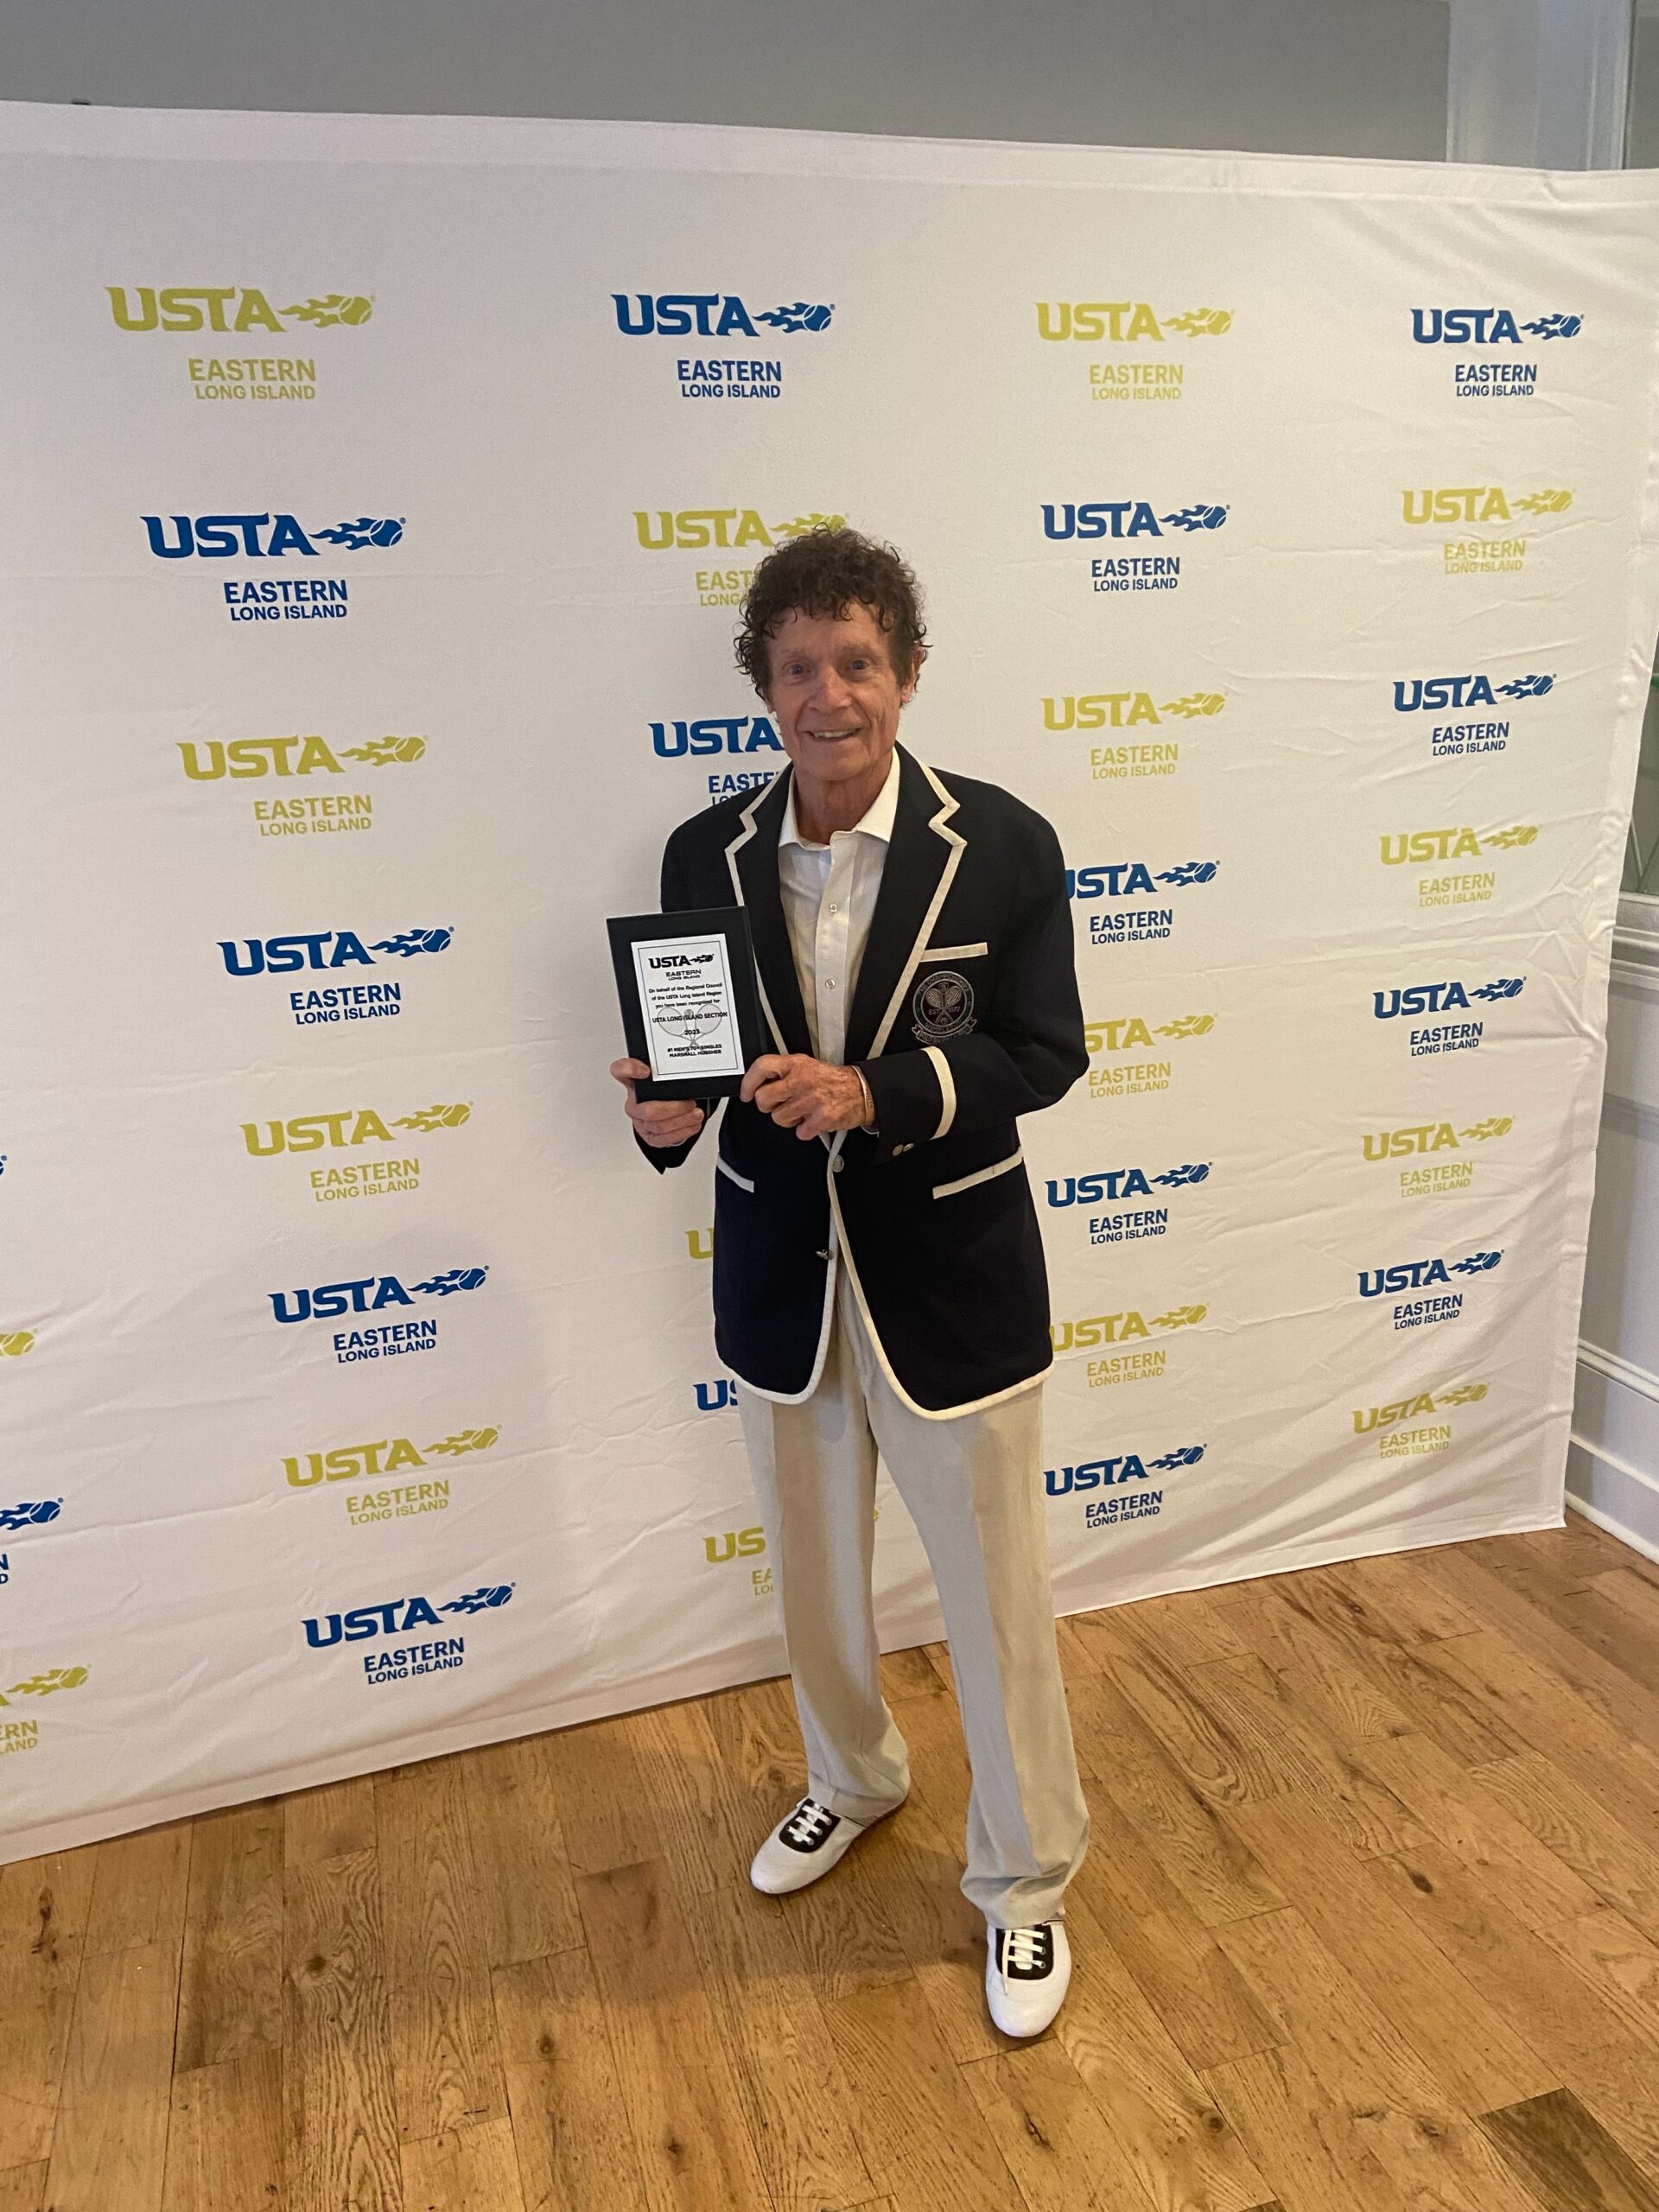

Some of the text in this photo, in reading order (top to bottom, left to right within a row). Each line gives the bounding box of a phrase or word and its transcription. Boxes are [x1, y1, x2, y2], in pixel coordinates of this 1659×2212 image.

[103, 285, 288, 333] USTA
[610, 294, 761, 337] USTA
[1033, 301, 1166, 341] USTA
[1409, 308, 1523, 344] USTA
[188, 359, 315, 381] EASTERN
[677, 359, 781, 382] EASTERN
[1090, 364, 1183, 385] EASTERN
[1455, 364, 1536, 382] EASTERN
[195, 385, 315, 400] LONG ISLAND
[682, 384, 780, 398] LONG ISLAND
[1092, 387, 1180, 400] LONG ISLAND
[1456, 385, 1534, 397] LONG ISLAND
[1400, 486, 1514, 524] USTA
[632, 508, 775, 549] USTA
[1039, 500, 1165, 539] USTA
[140, 512, 321, 558] USTA
[1444, 539, 1526, 560] EASTERN
[1091, 556, 1179, 577] EASTERN
[1444, 560, 1522, 575] LONG ISLAND
[224, 580, 347, 603] EASTERN
[696, 569, 752, 590] EAST
[1093, 578, 1177, 592] LONG ISLAND
[231, 605, 346, 621] LONG ISLAND
[1392, 674, 1498, 712] USTA
[1039, 690, 1163, 731] USTA
[648, 715, 785, 757] USTA
[1432, 721, 1510, 743] EASTERN
[175, 734, 346, 780] USTA
[1090, 743, 1178, 766] EASTERN
[1432, 741, 1505, 756] LONG ISLAND
[1092, 764, 1175, 780] LONG ISLAND
[254, 794, 372, 820] EASTERN
[260, 817, 371, 836] LONG ISLAND
[1378, 827, 1484, 865] USTA
[1418, 872, 1495, 895] EASTERN
[1419, 890, 1491, 907] LONG ISLAND
[1090, 909, 1173, 931] EASTERN
[1091, 928, 1170, 945] LONG ISLAND
[217, 931, 378, 976] USTA
[648, 955, 692, 969] USTA
[290, 982, 400, 1010] EASTERN
[1371, 982, 1471, 1019] USTA
[296, 1004, 399, 1025] LONG ISLAND
[1084, 1018, 1156, 1052] STA
[1410, 1021, 1483, 1045] EASTERN
[1410, 1039, 1479, 1057] LONG ISLAND
[1089, 1061, 1171, 1086] EASTERN
[1090, 1079, 1168, 1098] LONG ISLAND
[238, 1109, 397, 1157] USTA
[1360, 1122, 1461, 1161] USTA
[310, 1158, 419, 1188] EASTERN
[1401, 1161, 1472, 1186] EASTERN
[315, 1179, 418, 1202] LONG ISLAND
[1044, 1168, 1154, 1208] USTA
[1402, 1178, 1470, 1198] LONG ISLAND
[1090, 1208, 1167, 1233] EASTERN
[1091, 1225, 1165, 1245] LONG ISLAND
[1357, 1258, 1452, 1297] USTA
[267, 1276, 416, 1324] USTA
[1394, 1294, 1462, 1319] EASTERN
[1049, 1311, 1151, 1351] USTA
[1394, 1309, 1459, 1330] LONG ISLAND
[334, 1319, 436, 1351] EASTERN
[338, 1338, 435, 1363] LONG ISLAND
[1087, 1350, 1166, 1376] EASTERN
[1090, 1366, 1163, 1388] LONG ISLAND
[1351, 1393, 1437, 1433] USTA
[1380, 1426, 1452, 1449] EASTERN
[1380, 1441, 1449, 1459] LONG ISLAND
[279, 1438, 429, 1487] USTA
[1042, 1454, 1150, 1496] USTA
[346, 1479, 449, 1513] EASTERN
[1085, 1490, 1162, 1518] EASTERN
[351, 1498, 448, 1525] LONG ISLAND
[1087, 1506, 1160, 1529] LONG ISLAND
[702, 1526, 766, 1562] US
[300, 1597, 444, 1648] USTA
[364, 1637, 464, 1672] EASTERN
[368, 1656, 462, 1684] LONG ISLAND
